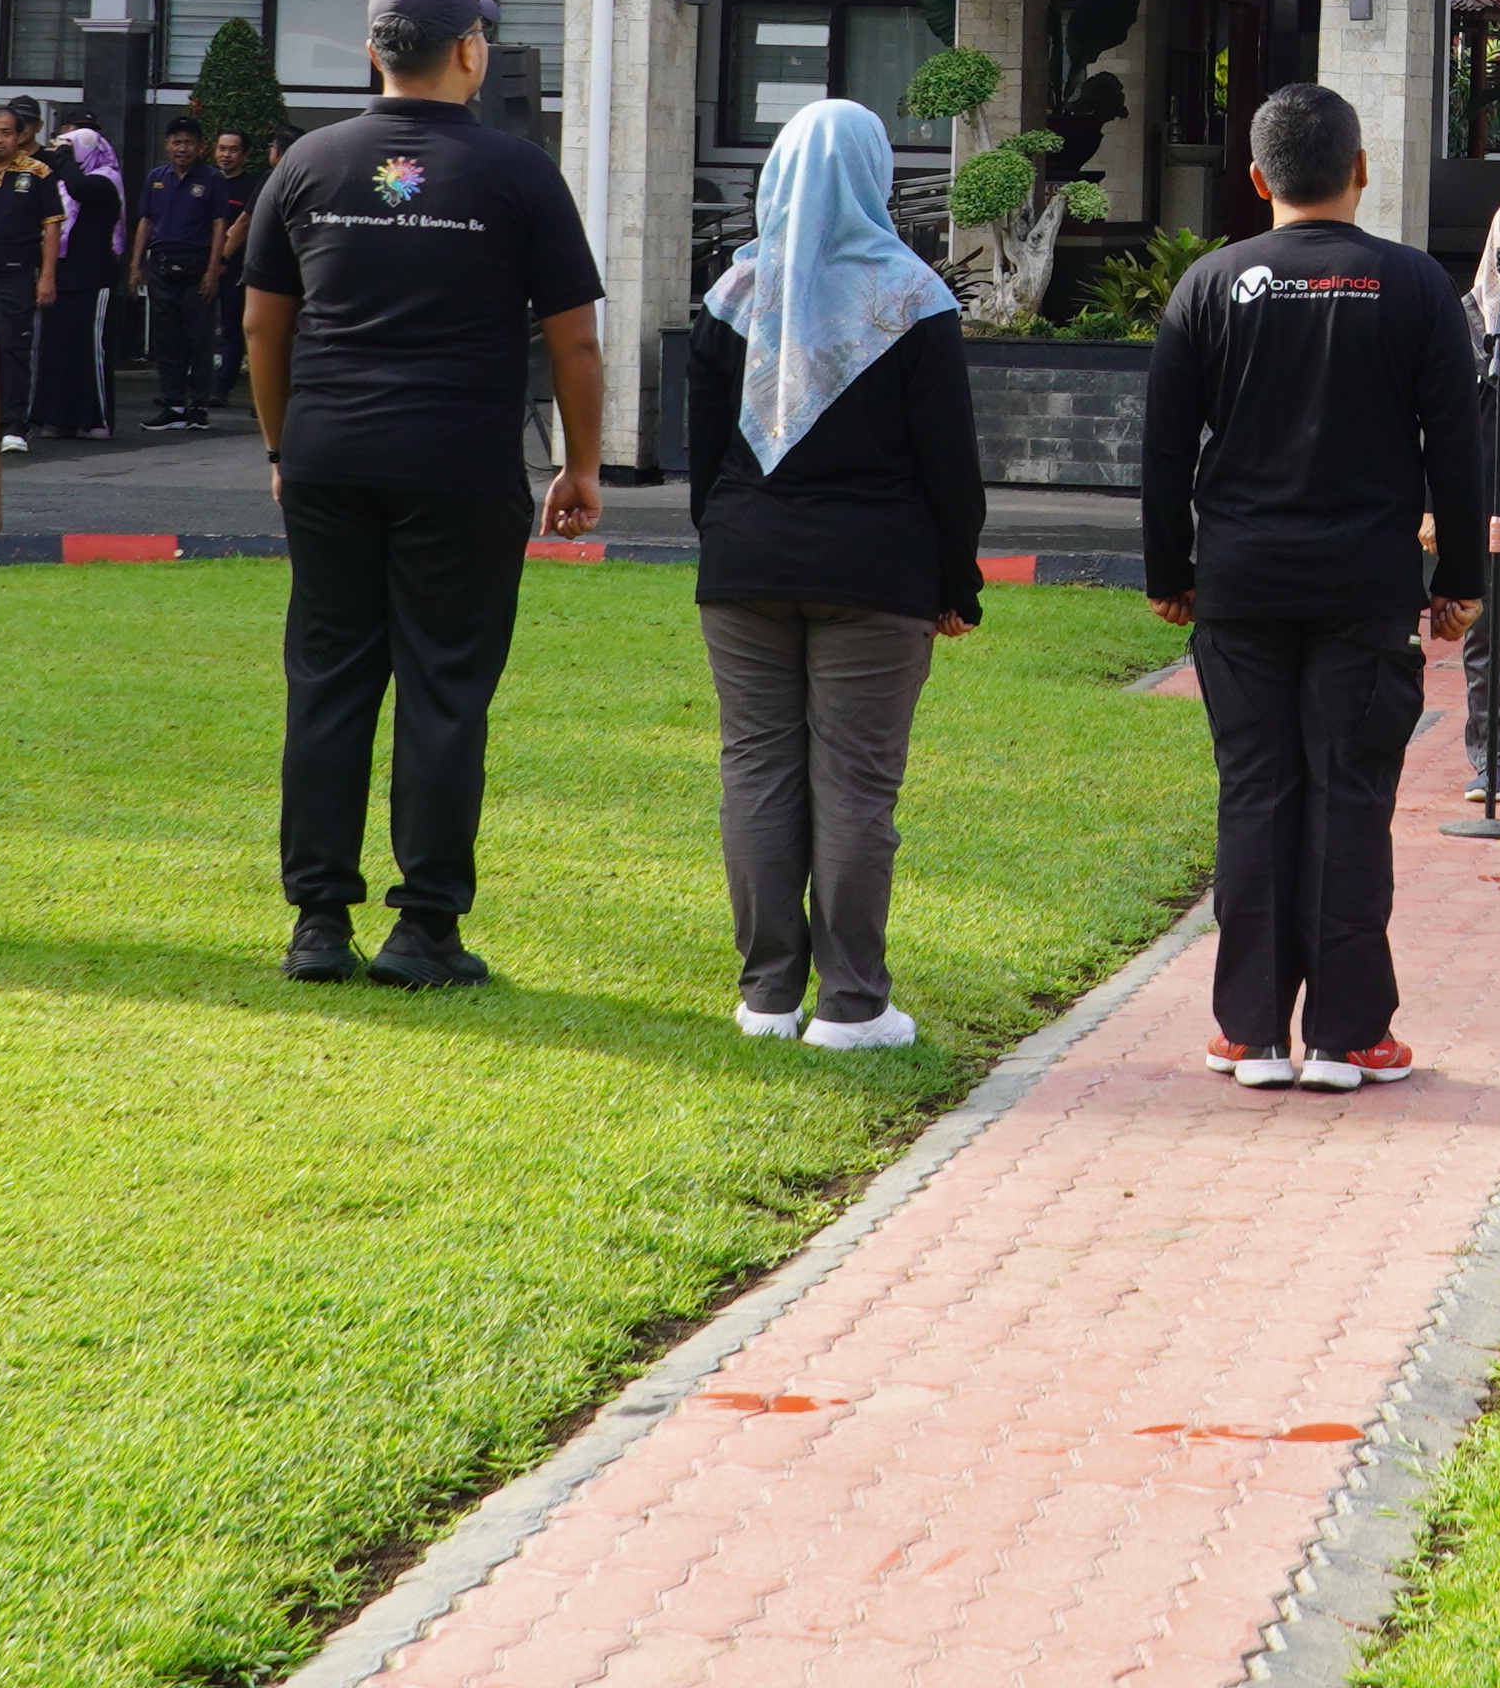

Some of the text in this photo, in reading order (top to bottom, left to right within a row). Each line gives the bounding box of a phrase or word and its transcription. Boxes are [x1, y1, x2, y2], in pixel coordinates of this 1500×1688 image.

[309, 212, 487, 232] Technopreneur 5.0 Wanna Be
[1271, 291, 1381, 300] broadband company
